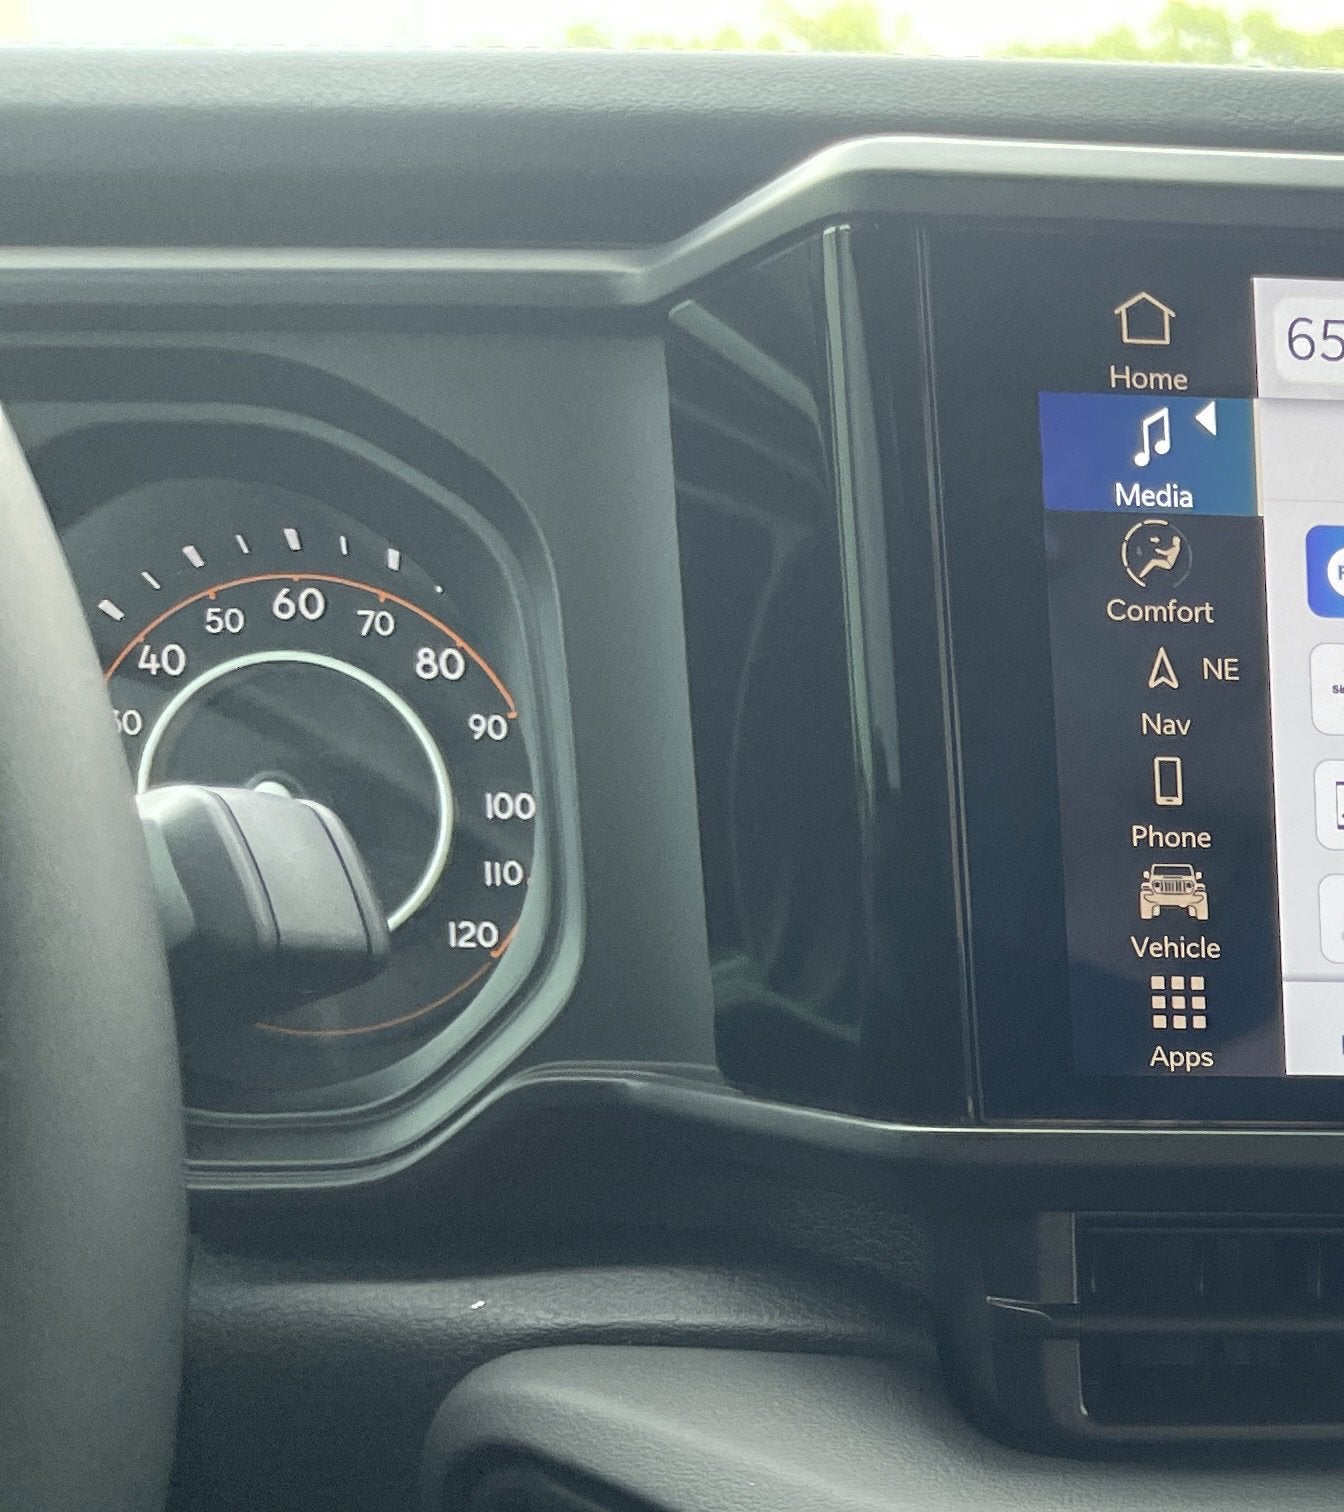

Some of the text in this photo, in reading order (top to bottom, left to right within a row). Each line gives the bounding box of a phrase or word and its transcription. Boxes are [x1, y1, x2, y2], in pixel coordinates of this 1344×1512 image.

[1110, 366, 1188, 391] Home
[1115, 483, 1193, 508] Media
[272, 588, 326, 620] 60
[1107, 599, 1214, 624] Comfort
[205, 608, 246, 634] 50
[356, 610, 395, 637] 70
[138, 645, 186, 676] 40
[416, 648, 466, 681] 80
[1203, 658, 1240, 681] NE
[468, 714, 508, 741] 90
[1141, 714, 1190, 736] Nav
[486, 793, 535, 820] 100
[1131, 826, 1212, 849] Phone
[484, 860, 524, 886] 110
[448, 921, 498, 948] 120
[1131, 937, 1221, 960] Vehicle
[1150, 1047, 1214, 1072] Apps
